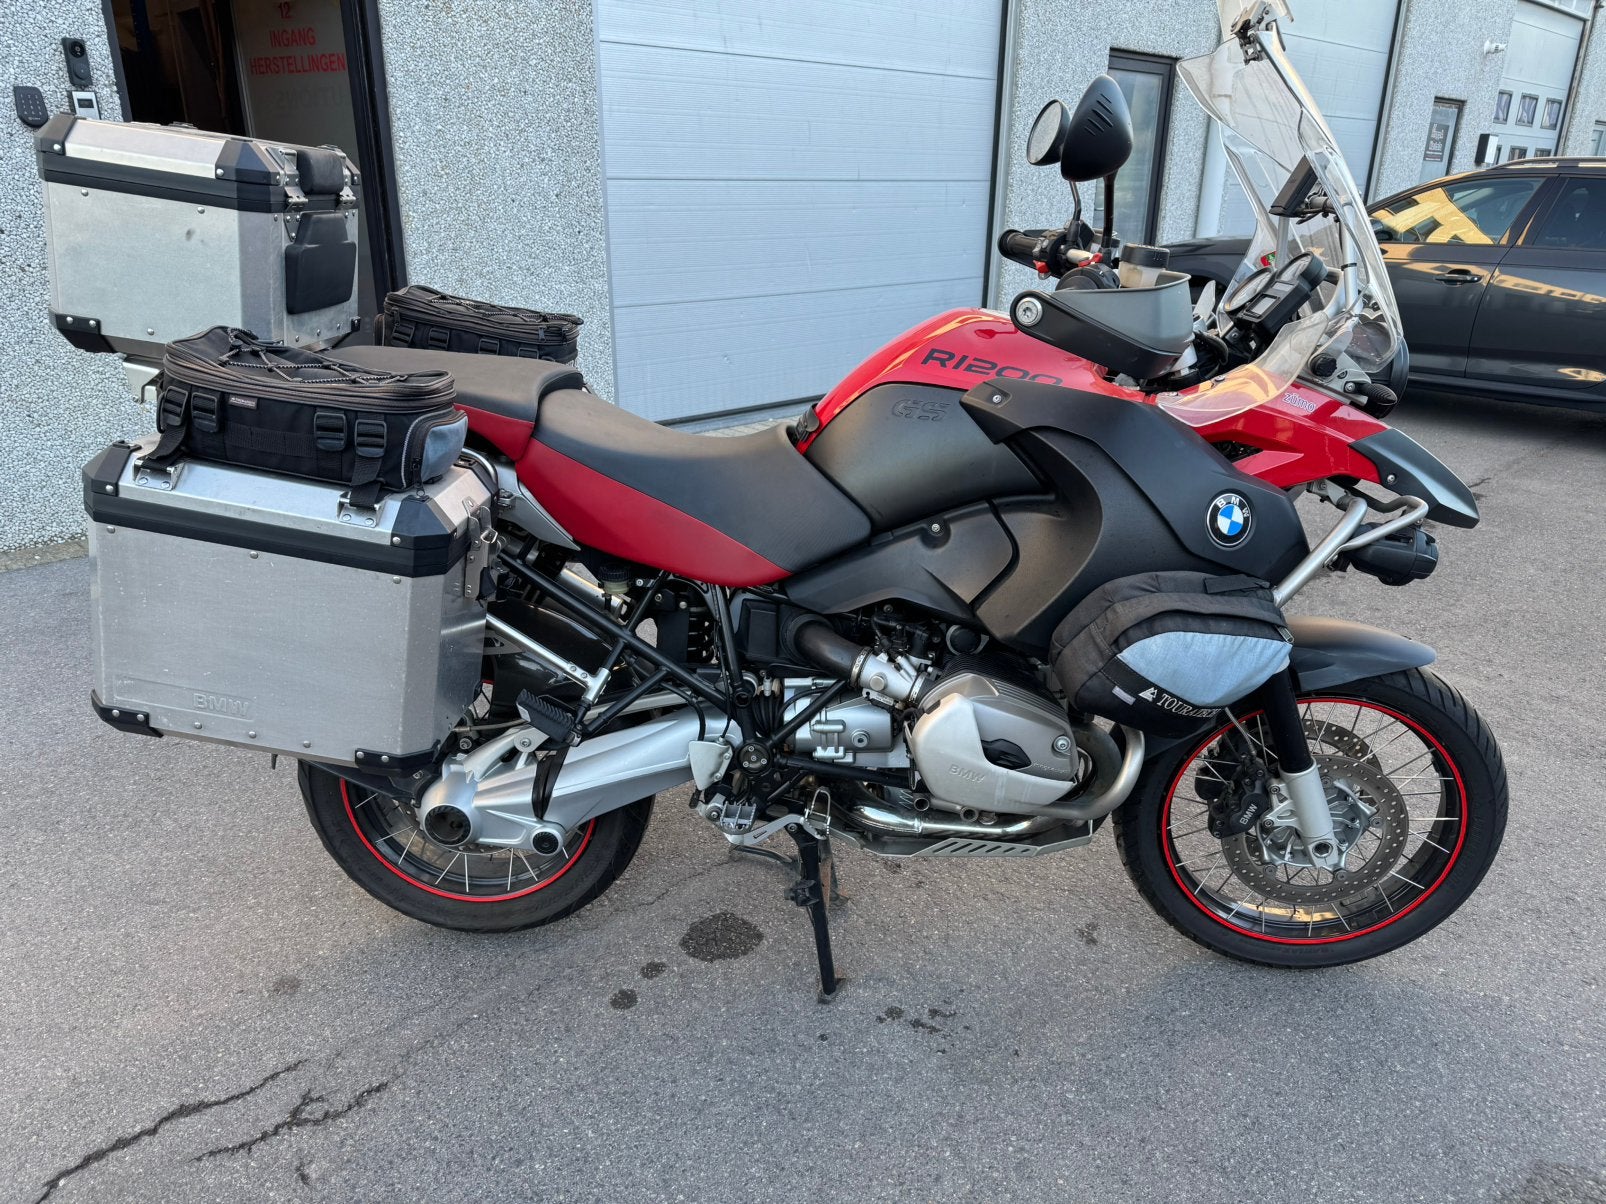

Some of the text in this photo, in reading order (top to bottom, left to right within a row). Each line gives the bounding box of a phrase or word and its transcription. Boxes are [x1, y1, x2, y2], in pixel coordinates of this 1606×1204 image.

[277, 2, 292, 19] 12
[269, 28, 316, 48] INGANG
[250, 53, 347, 75] HERSTELLINGEN
[1216, 496, 1250, 517] BMW
[193, 693, 249, 717] BMW
[949, 764, 985, 783] BMW
[1240, 803, 1258, 825] BMW
